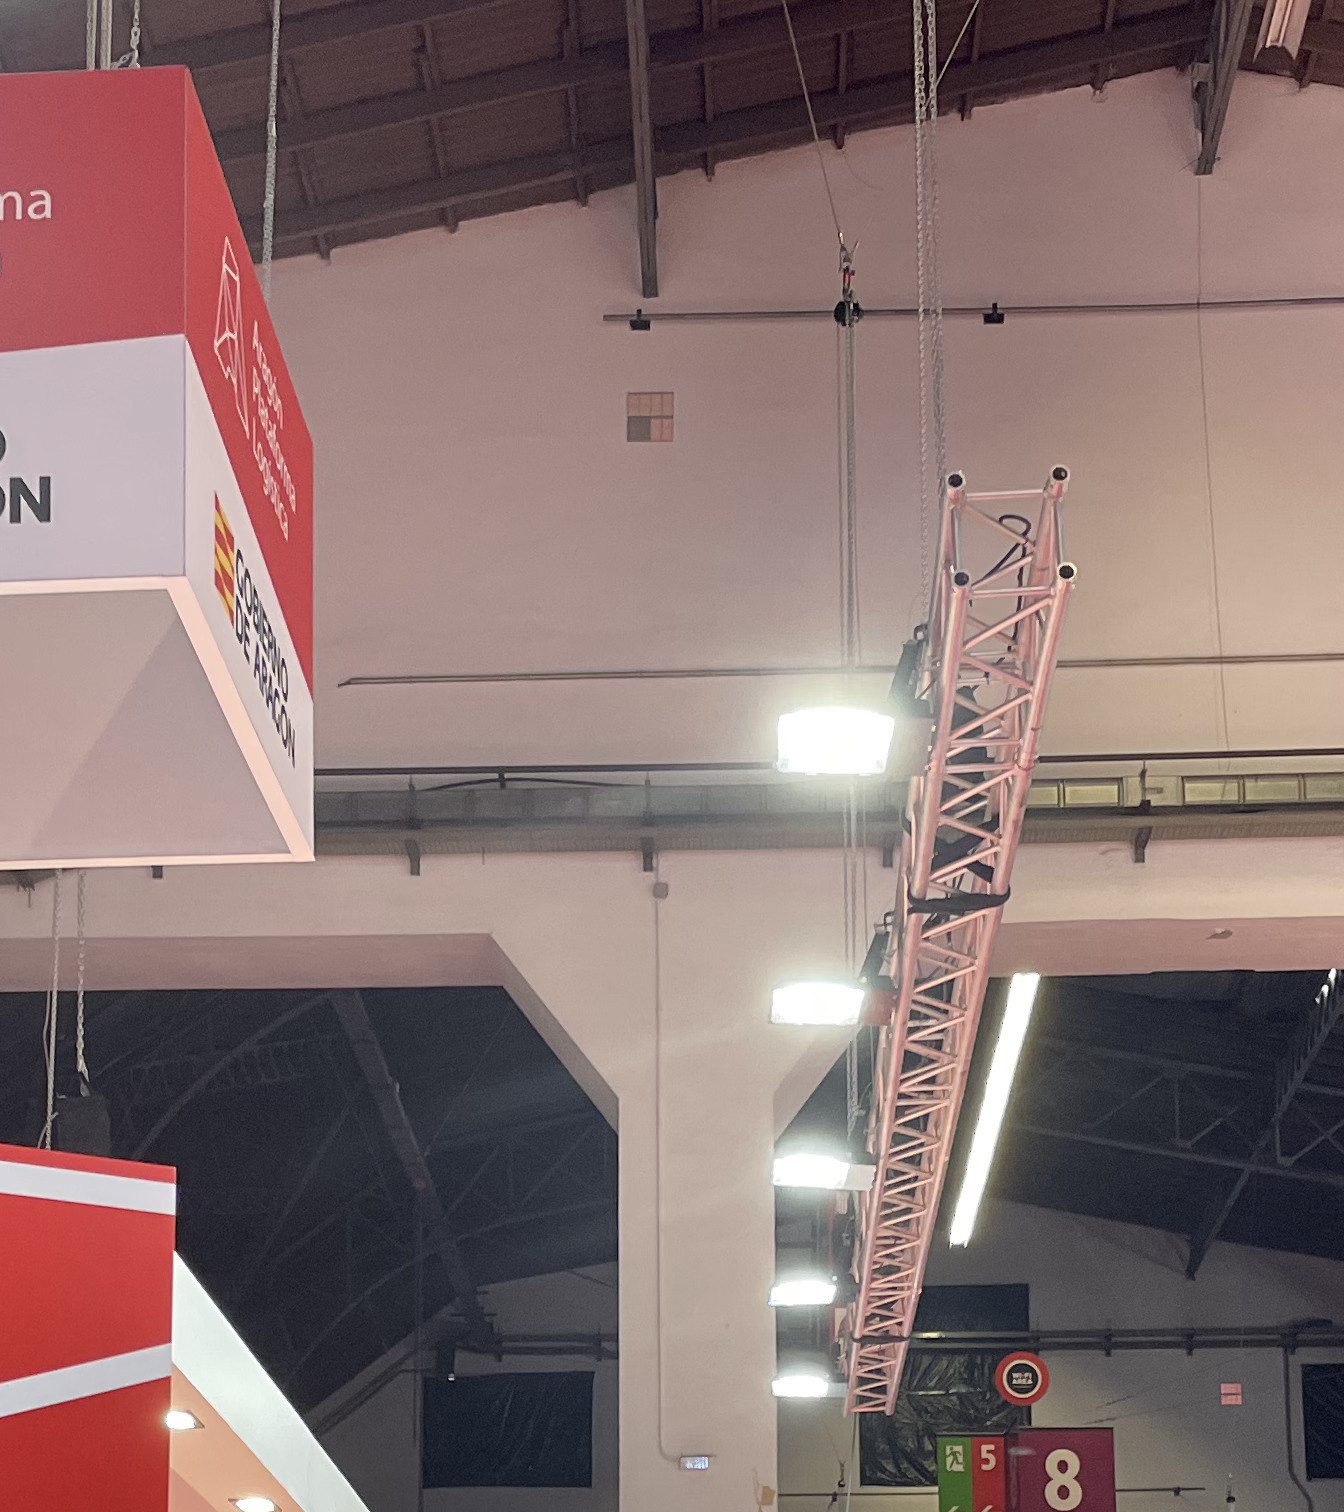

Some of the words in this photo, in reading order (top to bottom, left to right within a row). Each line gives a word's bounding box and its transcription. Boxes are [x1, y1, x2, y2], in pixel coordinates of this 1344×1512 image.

[235, 548, 289, 702] GOBIERNO
[235, 594, 251, 665] DE
[254, 640, 296, 769] ARAGON
[979, 1444, 997, 1471] 5
[1044, 1448, 1083, 1512] 8
